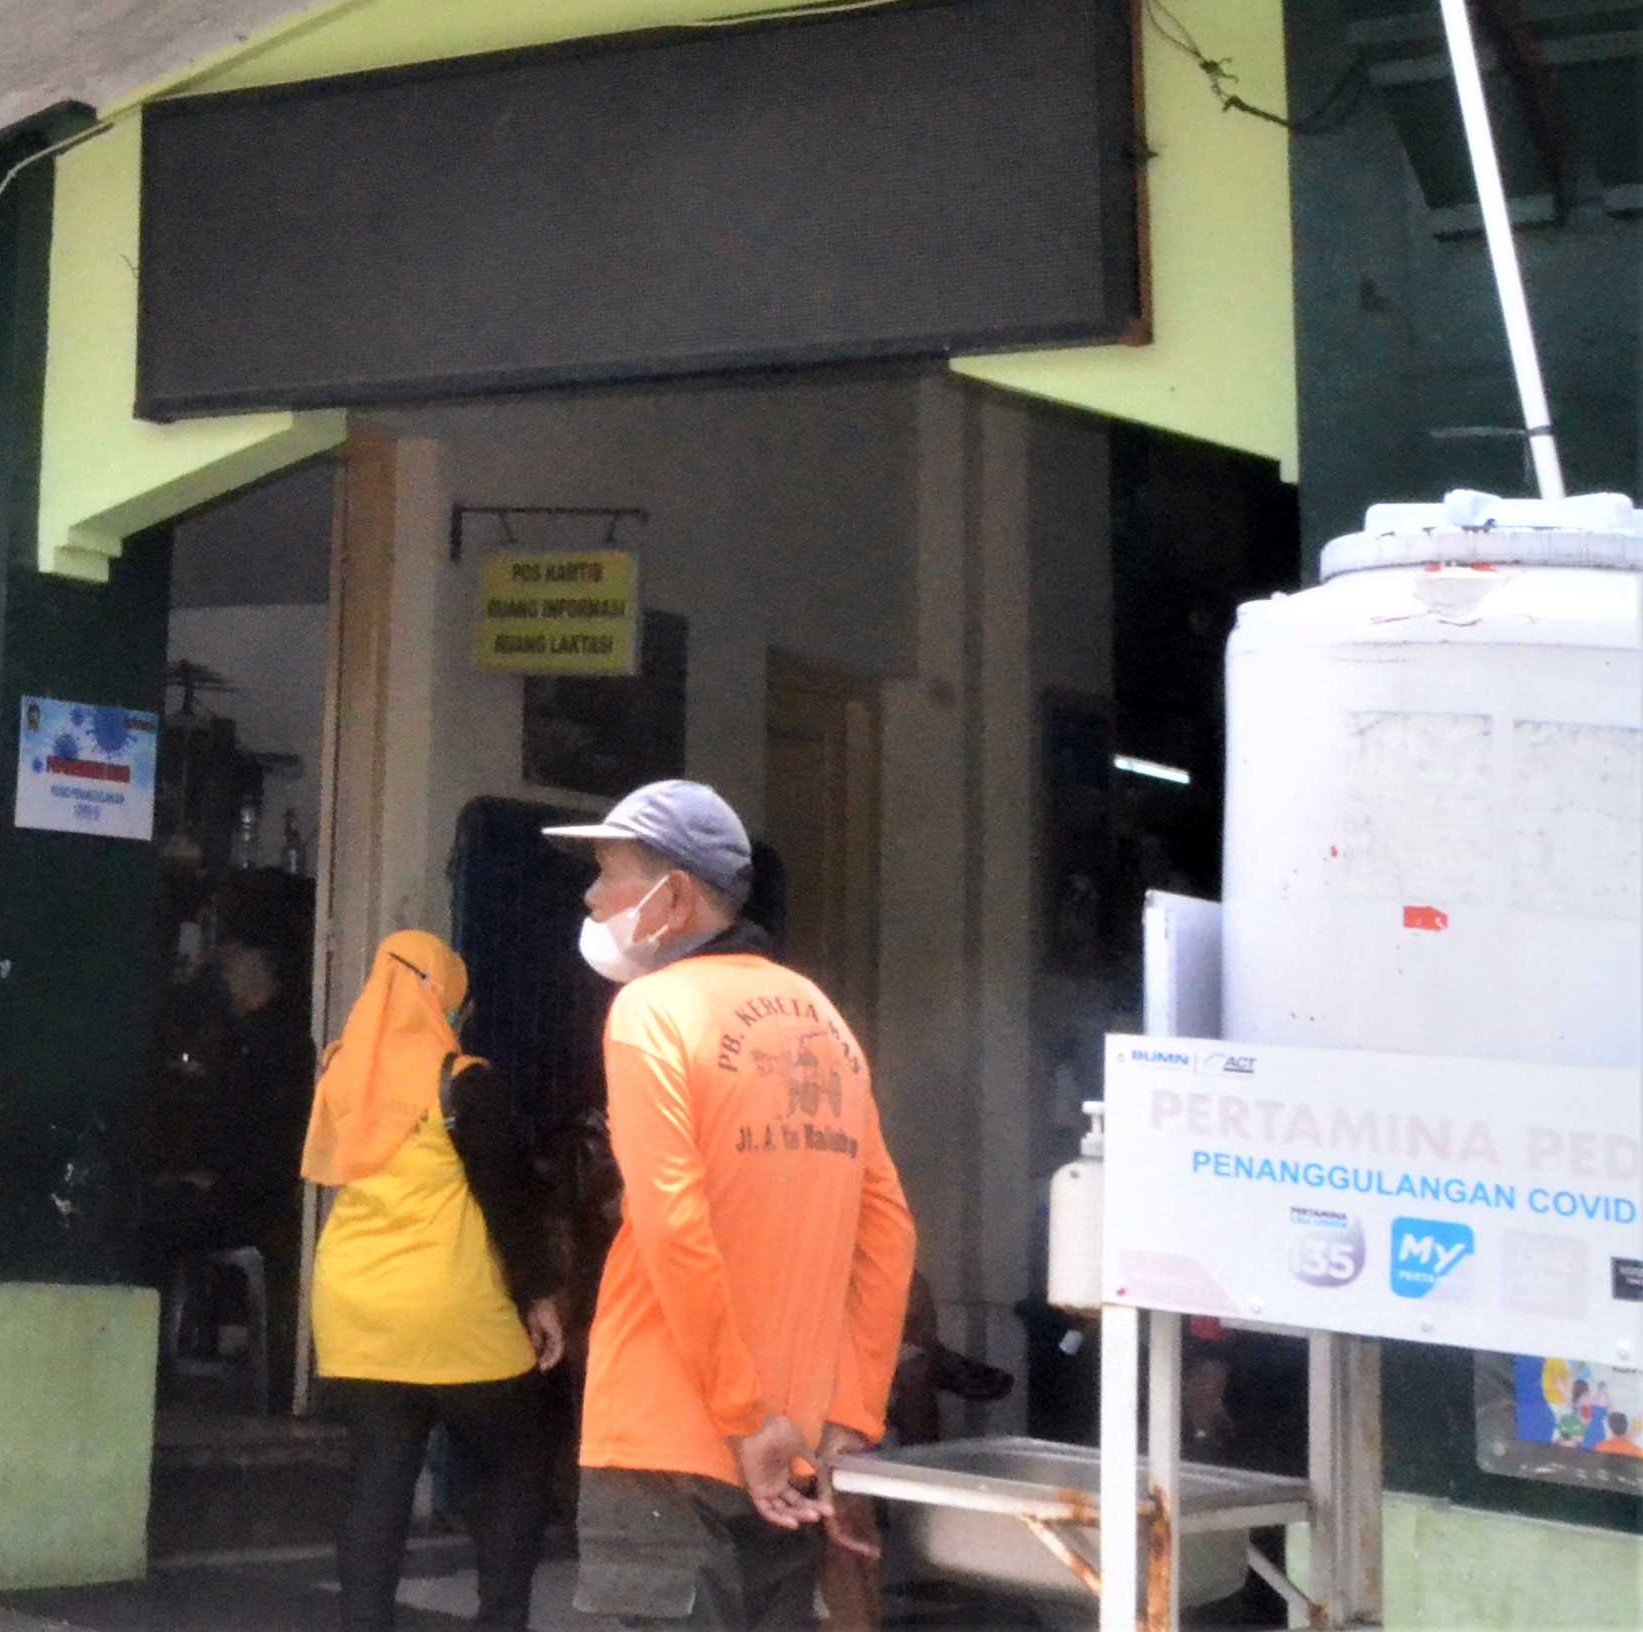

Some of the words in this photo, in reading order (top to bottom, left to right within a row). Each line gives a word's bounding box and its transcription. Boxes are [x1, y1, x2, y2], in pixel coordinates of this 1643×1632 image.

[1131, 1050, 1189, 1066] BUMN
[1224, 1055, 1257, 1072] ACT
[1149, 1087, 1501, 1166] PERTAMINA
[1192, 1150, 1516, 1210] PENANGGULANGAN
[1528, 1188, 1637, 1225] COVID
